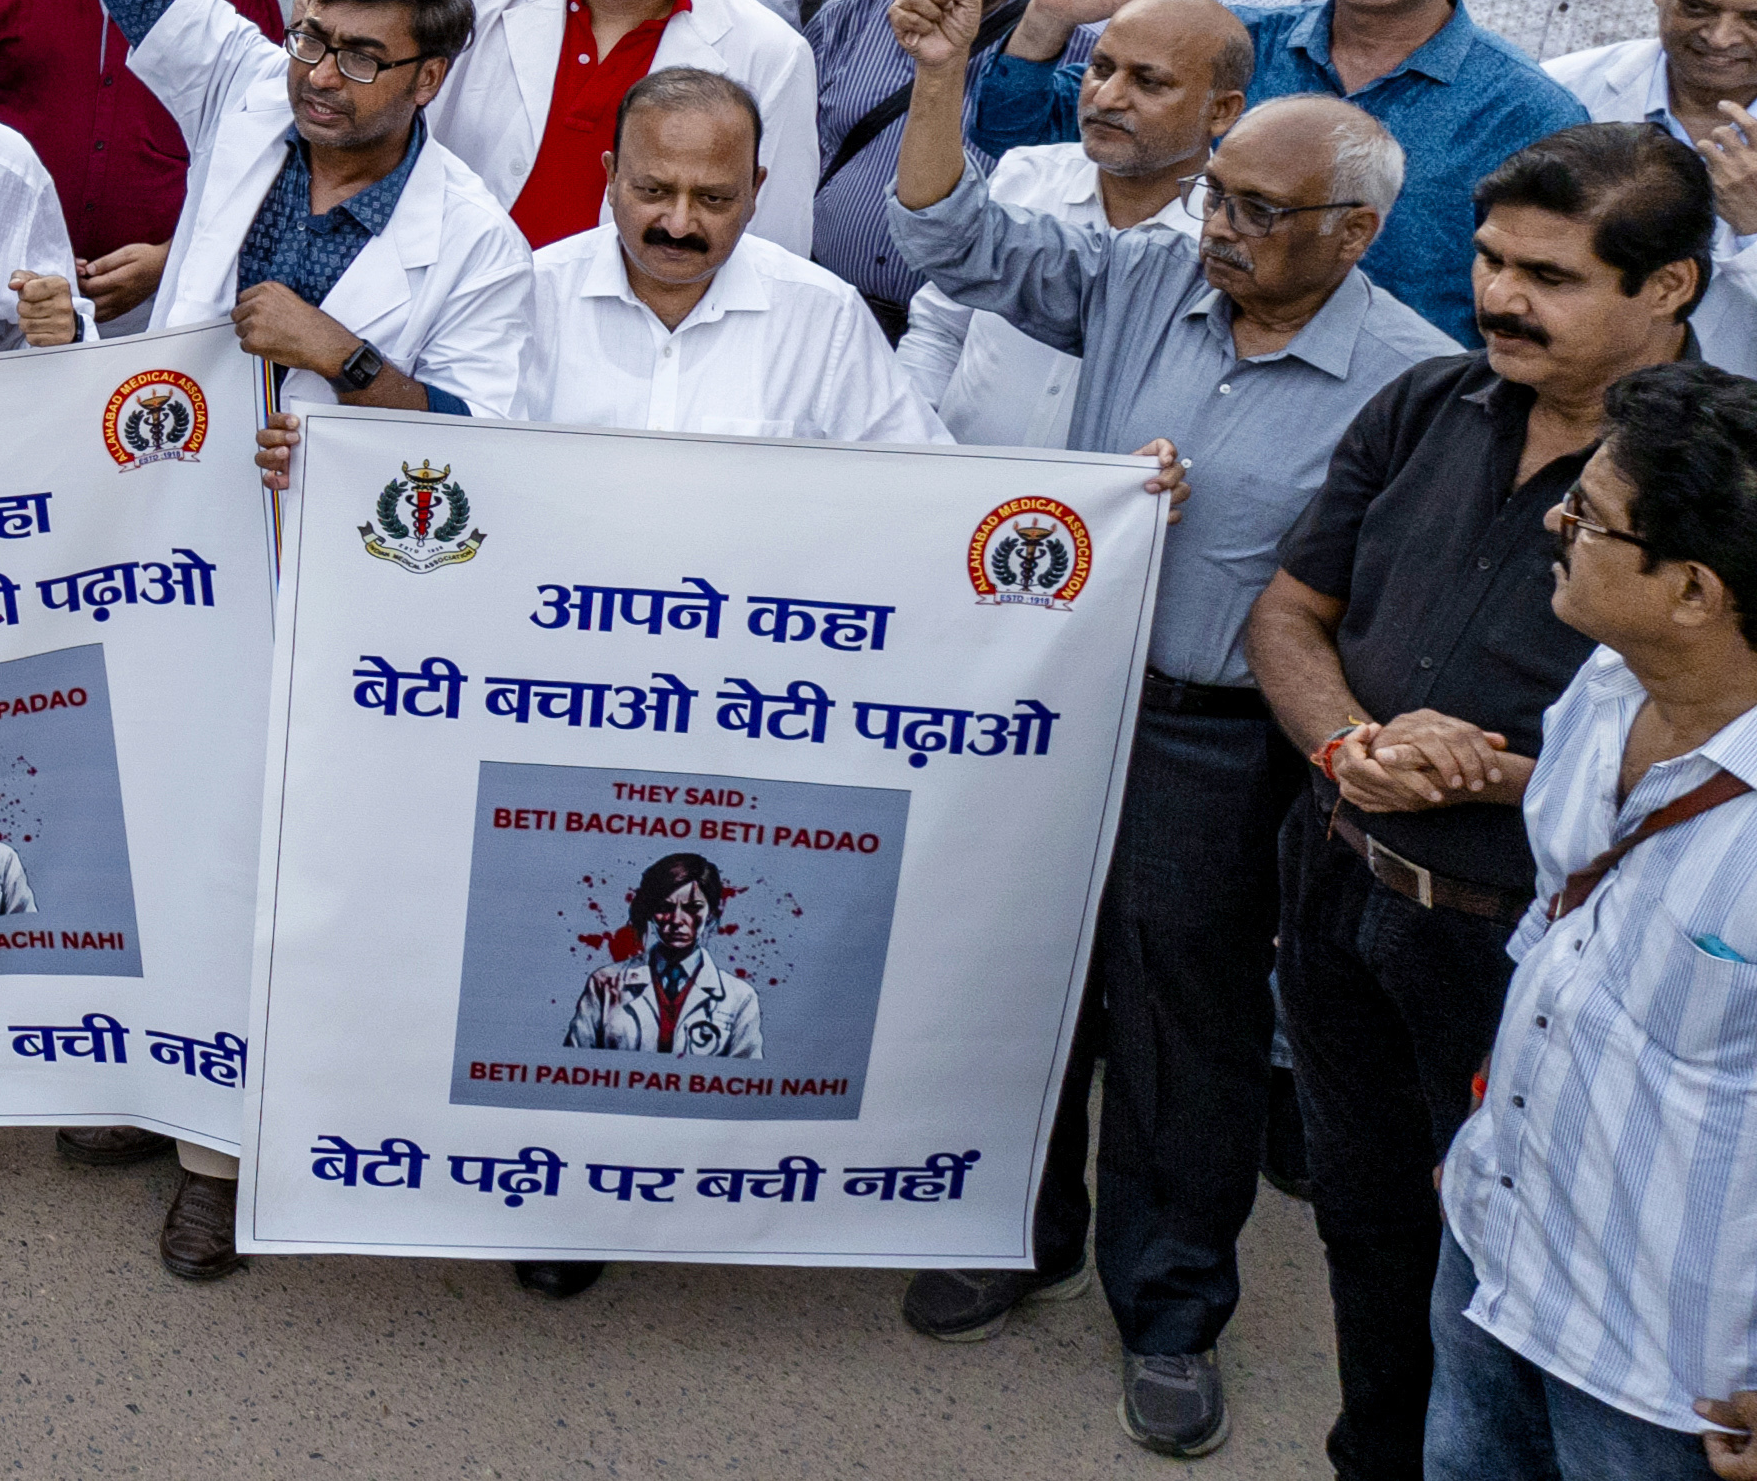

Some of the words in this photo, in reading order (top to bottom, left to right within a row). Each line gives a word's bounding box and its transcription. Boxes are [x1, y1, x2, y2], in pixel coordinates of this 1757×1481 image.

[530, 577, 729, 638] आपने
[747, 596, 895, 651] कहा
[353, 656, 468, 719] बेटी
[485, 673, 699, 733] बचाओ
[716, 678, 835, 743] बेटी
[853, 700, 1060, 768] पढ़ाओ
[613, 783, 679, 803] THEY
[684, 788, 744, 807] SAID
[494, 809, 556, 830] BETI
[566, 812, 691, 838] BACHAO
[700, 820, 764, 844] BETI
[774, 827, 879, 853] PADAO
[470, 1062, 527, 1082] BETI
[536, 1066, 620, 1088] PADHI
[629, 1071, 680, 1091] PAR
[689, 1075, 773, 1095] BACHI
[781, 1079, 847, 1095] NAHI
[311, 1135, 430, 1188] बेटी
[448, 1147, 568, 1207] पढ़ी
[586, 1164, 684, 1202] पर
[697, 1156, 826, 1202] बची
[844, 1150, 981, 1202] नहीं
